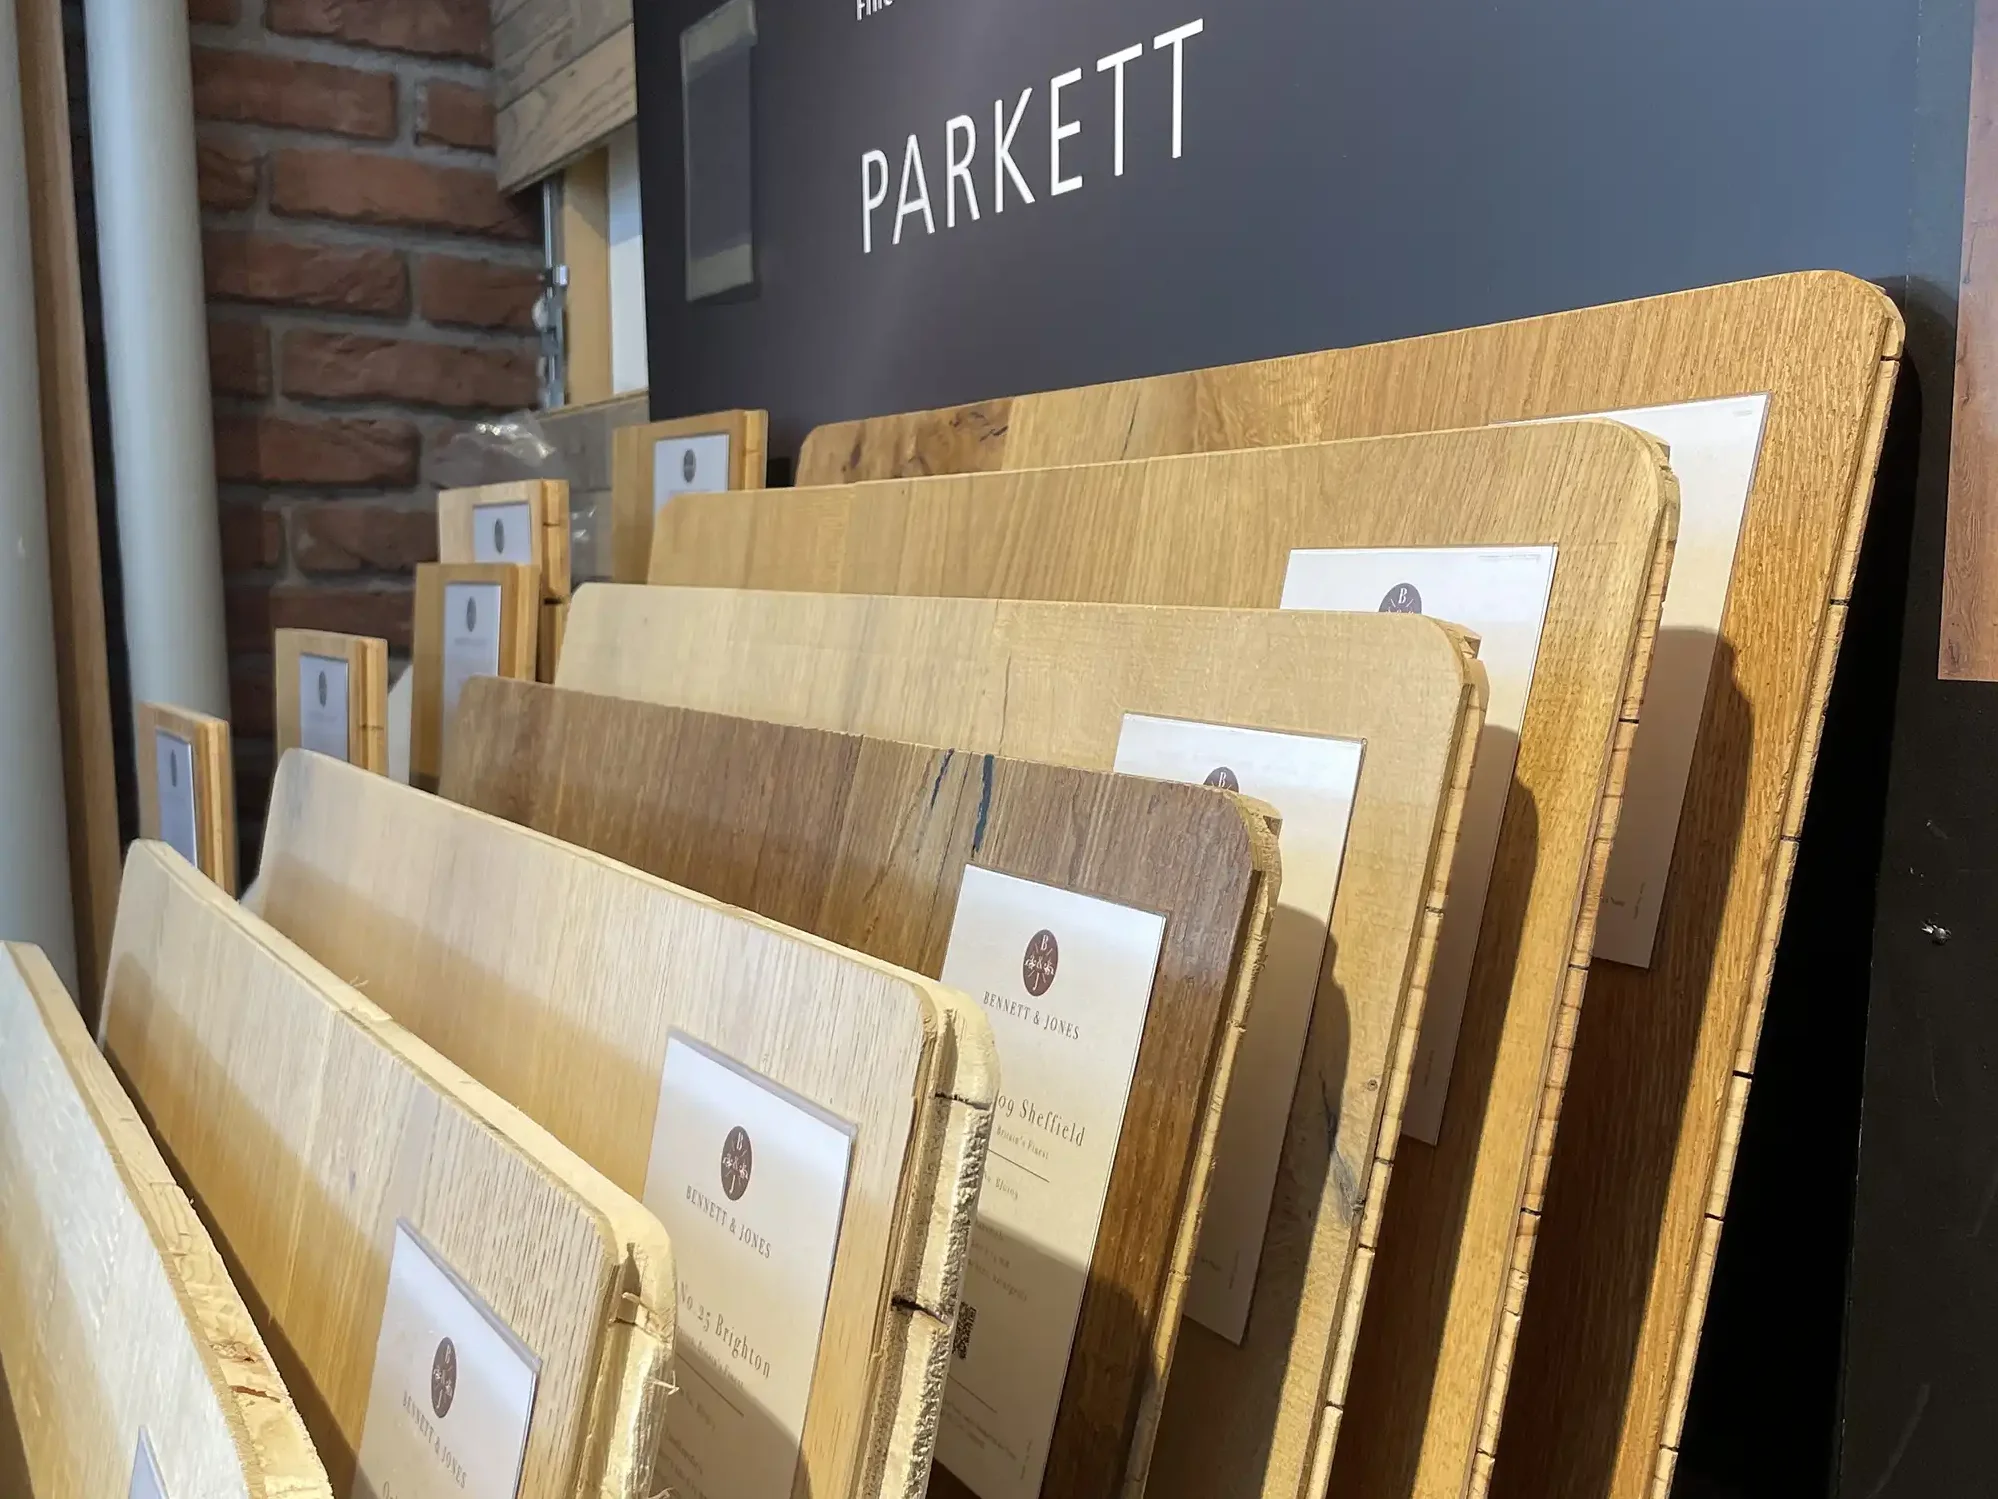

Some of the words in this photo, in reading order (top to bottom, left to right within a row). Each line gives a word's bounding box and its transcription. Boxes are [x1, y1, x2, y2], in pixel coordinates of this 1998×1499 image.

[861, 18, 1204, 254] PARKETT
[1398, 587, 1407, 604] B
[1041, 934, 1049, 951] B
[983, 991, 1031, 1021] BENNETT
[1033, 1010, 1040, 1026] &
[1043, 1014, 1080, 1041] JONES
[1019, 1098, 1086, 1147] Sheffield
[686, 1184, 728, 1226] BENNETT
[729, 1217, 736, 1235] &
[738, 1224, 772, 1259] JONES
[715, 1313, 771, 1379] Brighton
[403, 1390, 434, 1444] BENNETT
[442, 1446, 467, 1489] JONES
